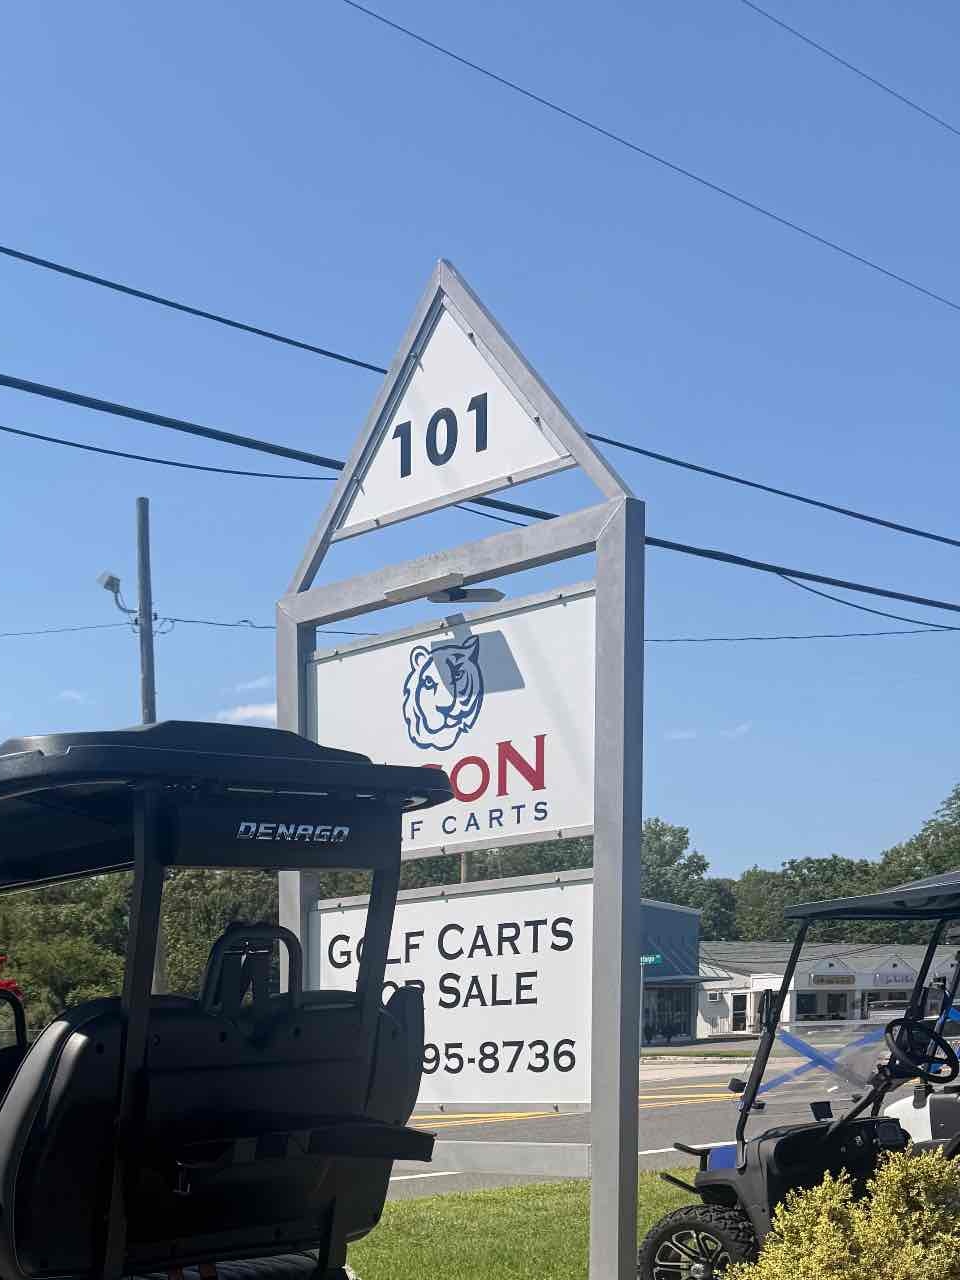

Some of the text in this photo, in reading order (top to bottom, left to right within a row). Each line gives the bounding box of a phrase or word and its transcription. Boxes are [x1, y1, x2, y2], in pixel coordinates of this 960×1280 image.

[392, 392, 489, 479] 101
[420, 733, 547, 803] ON
[237, 821, 351, 843] DENAGO
[441, 801, 549, 835] CARTS
[328, 916, 575, 969] GF CARTS
[437, 971, 539, 1010] SALE
[422, 1038, 577, 1075] 95-8736
